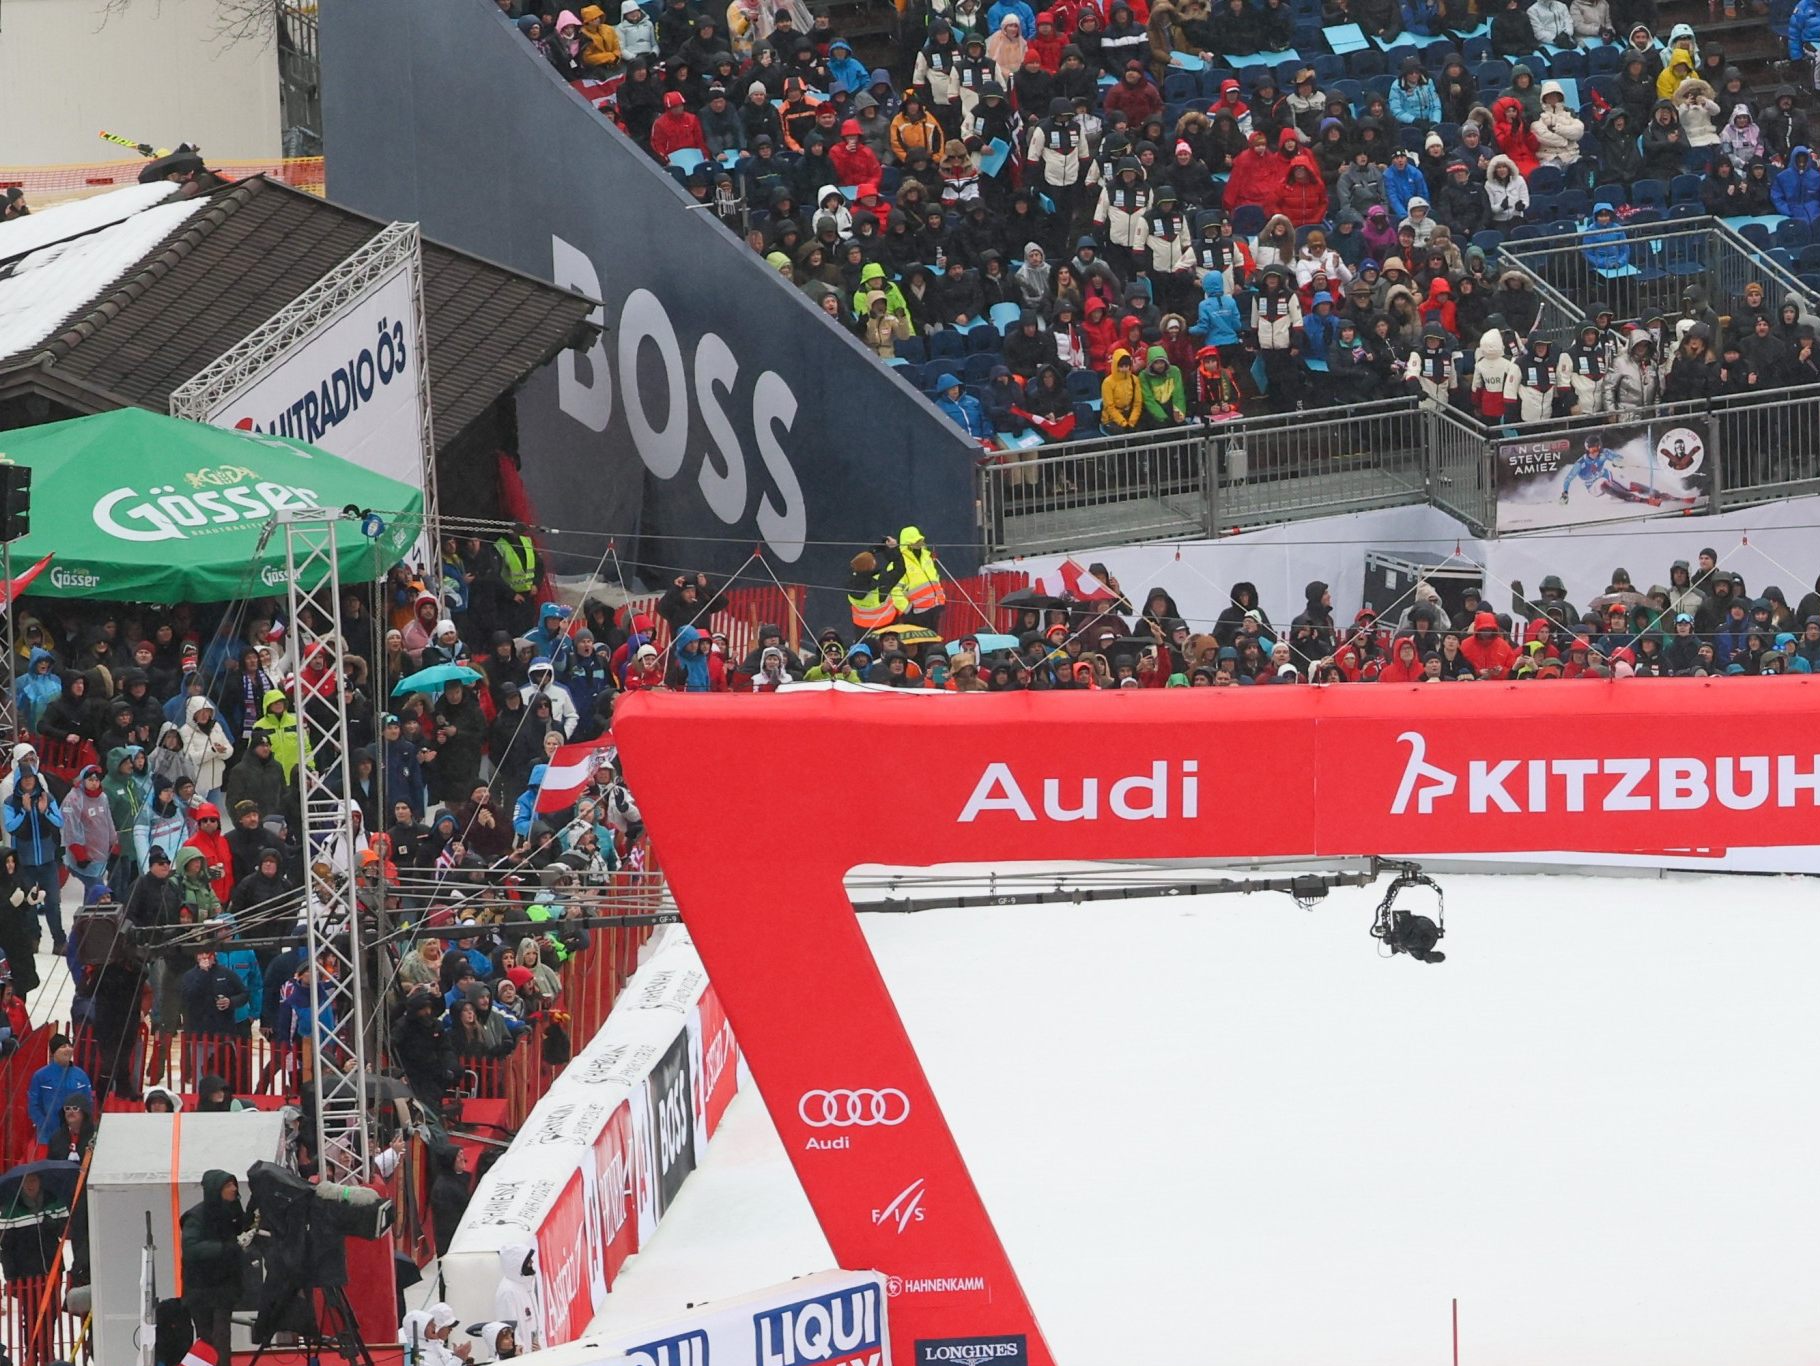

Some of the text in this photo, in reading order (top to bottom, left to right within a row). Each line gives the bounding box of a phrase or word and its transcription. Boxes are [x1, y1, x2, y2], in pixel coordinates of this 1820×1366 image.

[376, 316, 407, 386] Ö3
[552, 234, 806, 563] BOSS
[1509, 452, 1561, 466] STEVEN
[1515, 462, 1558, 475] AMIEZ
[92, 482, 323, 542] Gösser
[51, 567, 100, 589] Gösser
[956, 760, 1198, 822] Audi
[998, 897, 1017, 905] GF-9
[659, 915, 678, 924] GF-9
[658, 1069, 687, 1177] BOSS
[805, 1136, 850, 1150] Audi
[905, 1277, 985, 1292] HAHNENKAMM
[925, 1342, 1018, 1361] LONGINES
